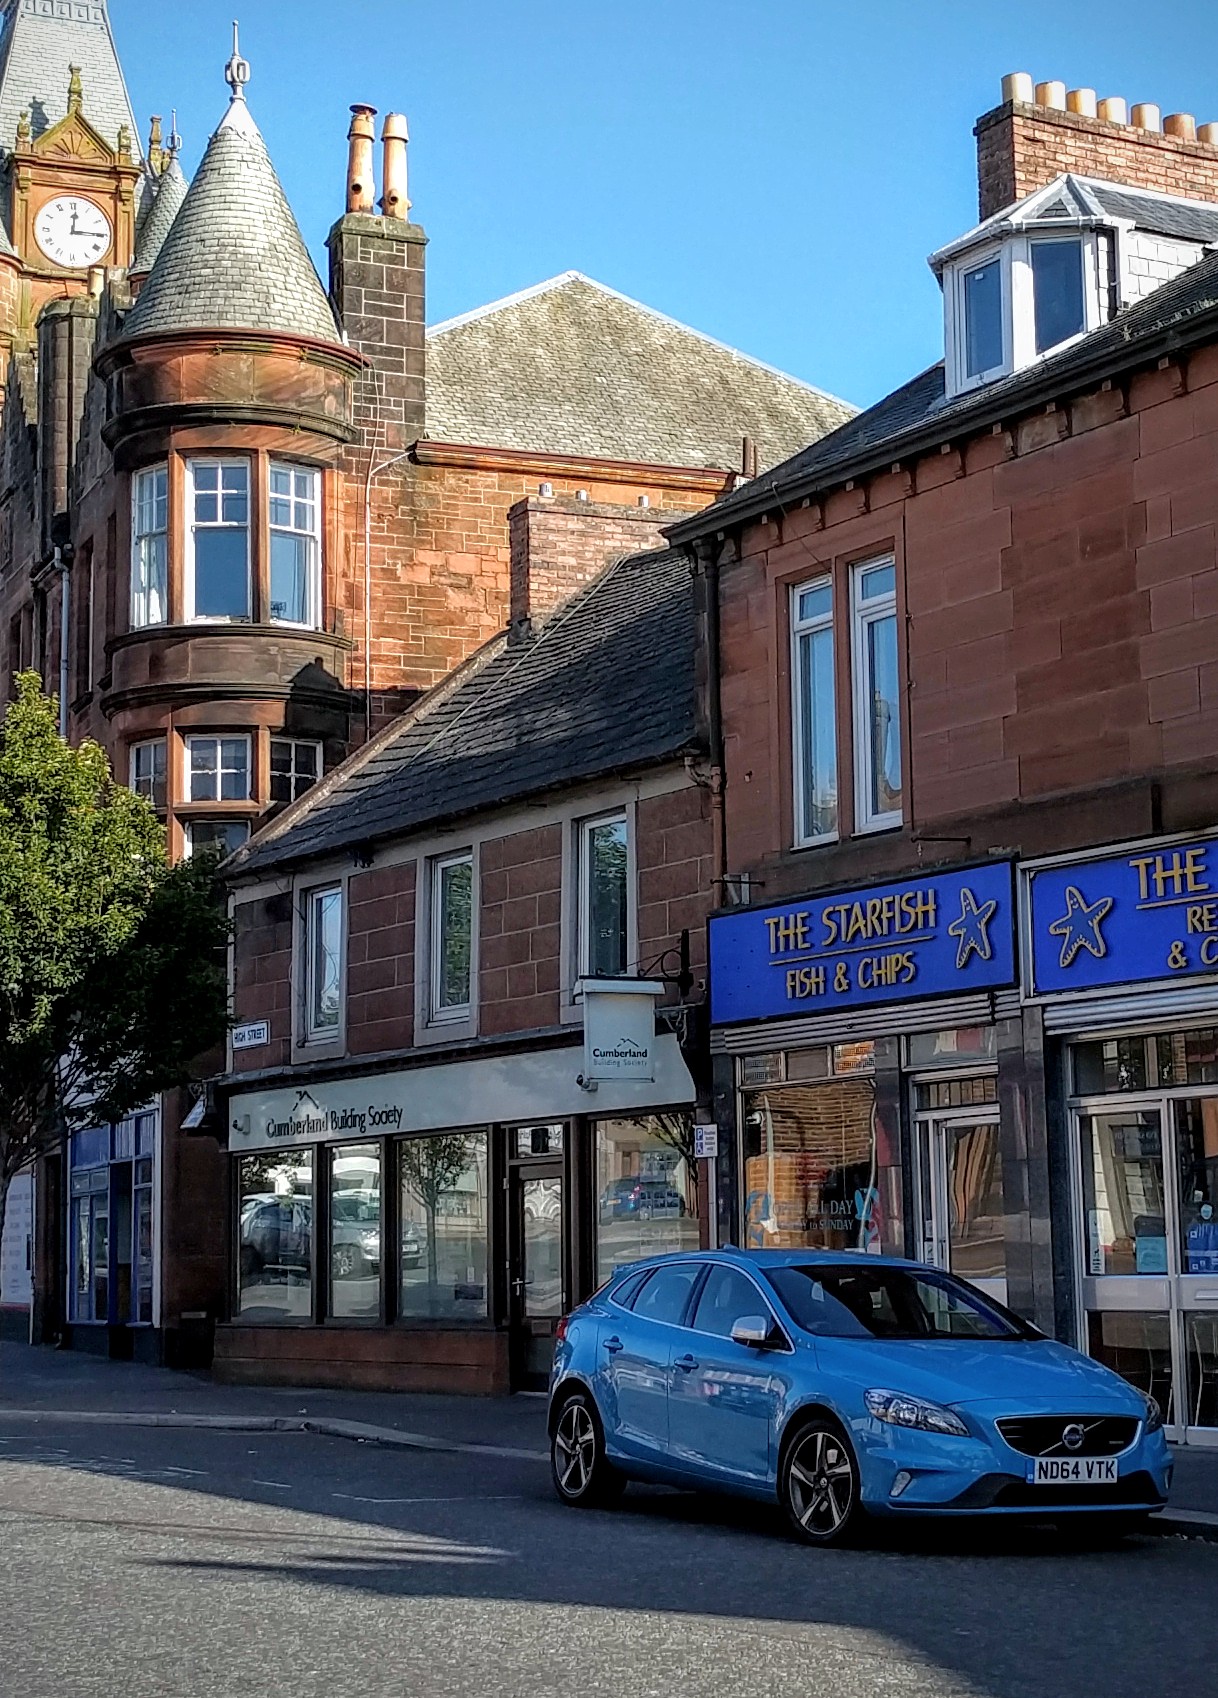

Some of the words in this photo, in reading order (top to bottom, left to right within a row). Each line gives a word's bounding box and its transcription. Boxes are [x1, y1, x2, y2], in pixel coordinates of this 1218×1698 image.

[1129, 848, 1209, 899] THE
[765, 911, 811, 954] THE
[822, 888, 936, 946] STARFISH
[1167, 940, 1188, 969] &
[786, 965, 825, 999] FISH
[834, 962, 849, 992] &
[858, 951, 915, 989] CHIPS
[234, 1031, 246, 1043] HIGH
[247, 1027, 265, 1041] STREET
[593, 1048, 648, 1058] Cumberland
[593, 1058, 620, 1067] Building
[623, 1059, 647, 1067] Society
[267, 1110, 328, 1139] Cumberland
[331, 1108, 366, 1134] Building
[368, 1103, 403, 1129] Society
[830, 1200, 853, 1215] DAY
[819, 1219, 854, 1231] SUNDAY
[1038, 1460, 1080, 1480] ND64
[1085, 1460, 1115, 1480] VTK
